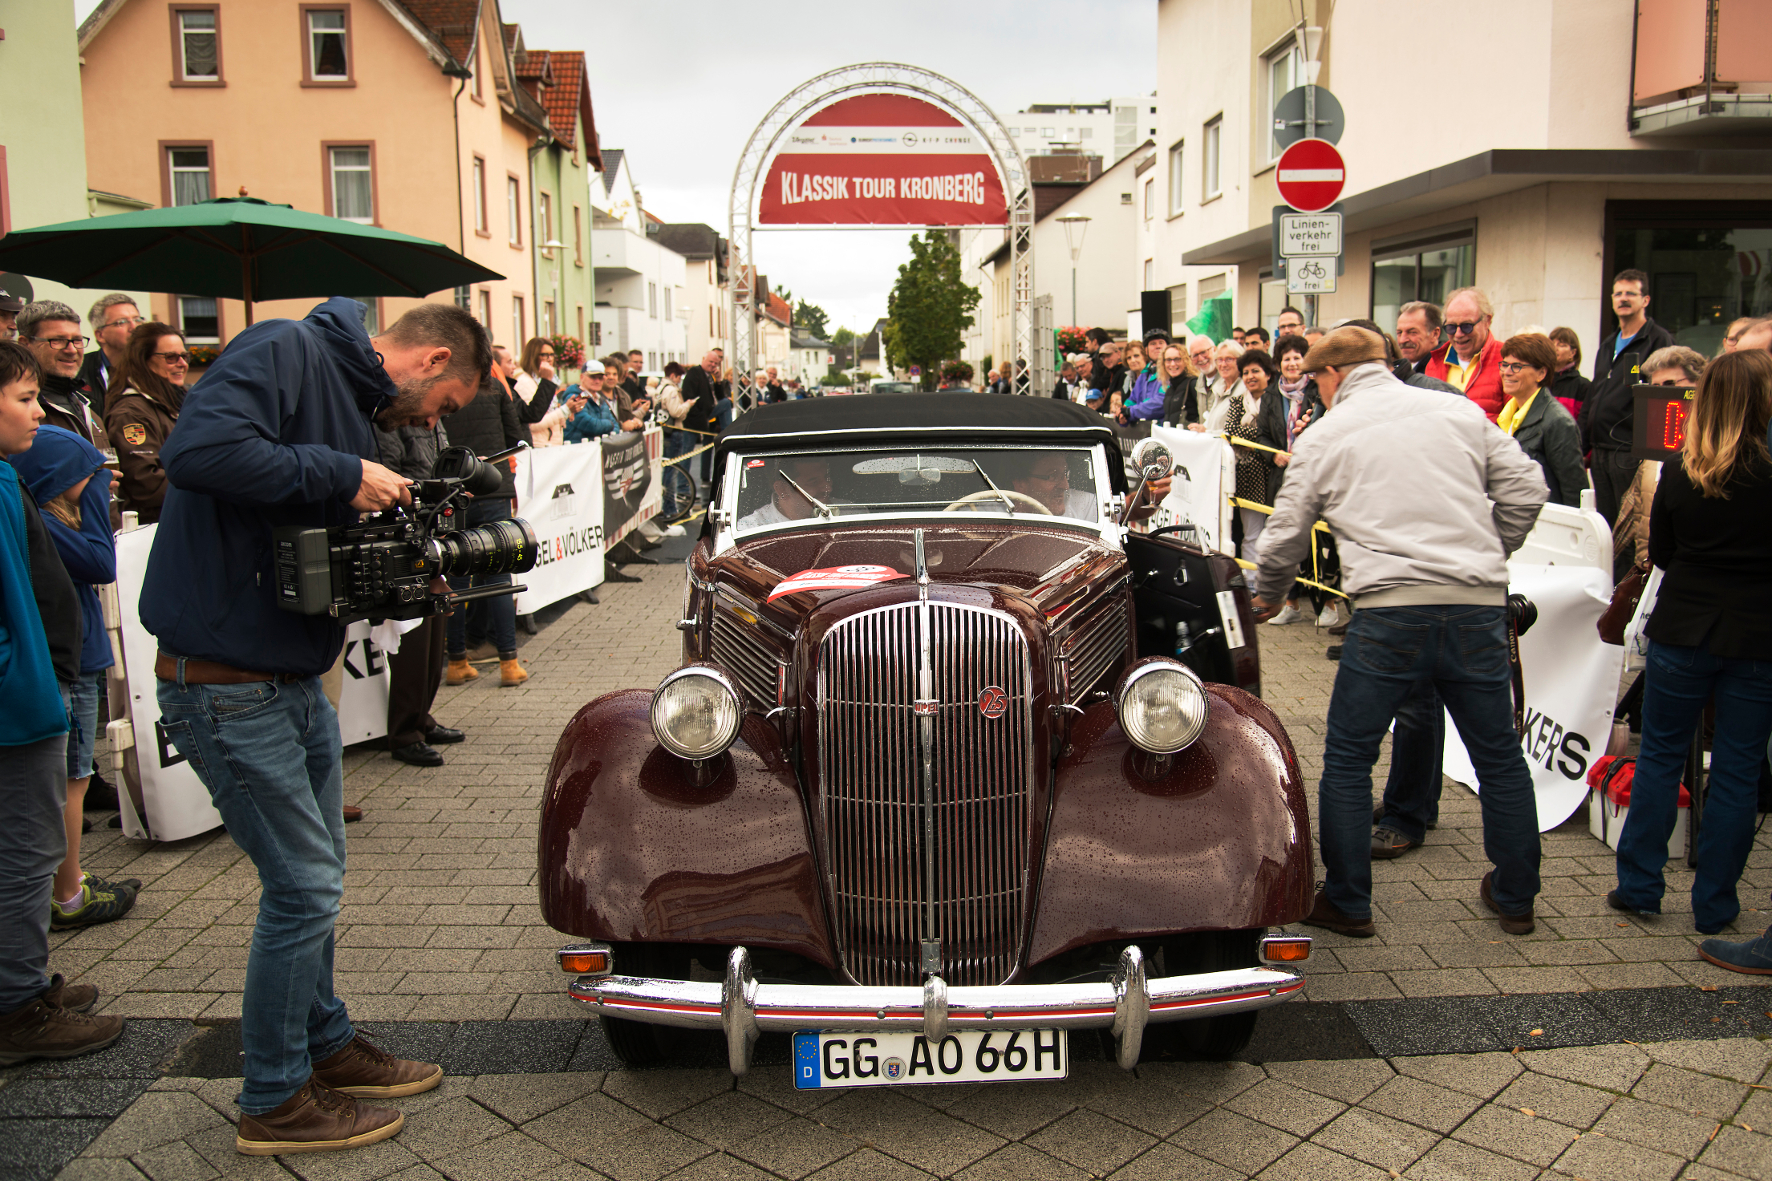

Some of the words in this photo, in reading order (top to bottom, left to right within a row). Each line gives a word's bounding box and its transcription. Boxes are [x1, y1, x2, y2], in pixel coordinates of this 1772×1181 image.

[781, 171, 849, 205] KLASSIK
[852, 177, 896, 198] TOUR
[900, 171, 985, 205] KRONBERG
[1291, 218, 1330, 229] Linien-
[1289, 230, 1332, 240] verkehr
[1301, 241, 1320, 251] frei
[1304, 281, 1320, 290] frei
[1509, 629, 1517, 663] Canon
[914, 702, 939, 713] OPEL
[822, 1037, 880, 1080] GG
[975, 1027, 1061, 1073] 66H
[803, 1066, 813, 1079] D
